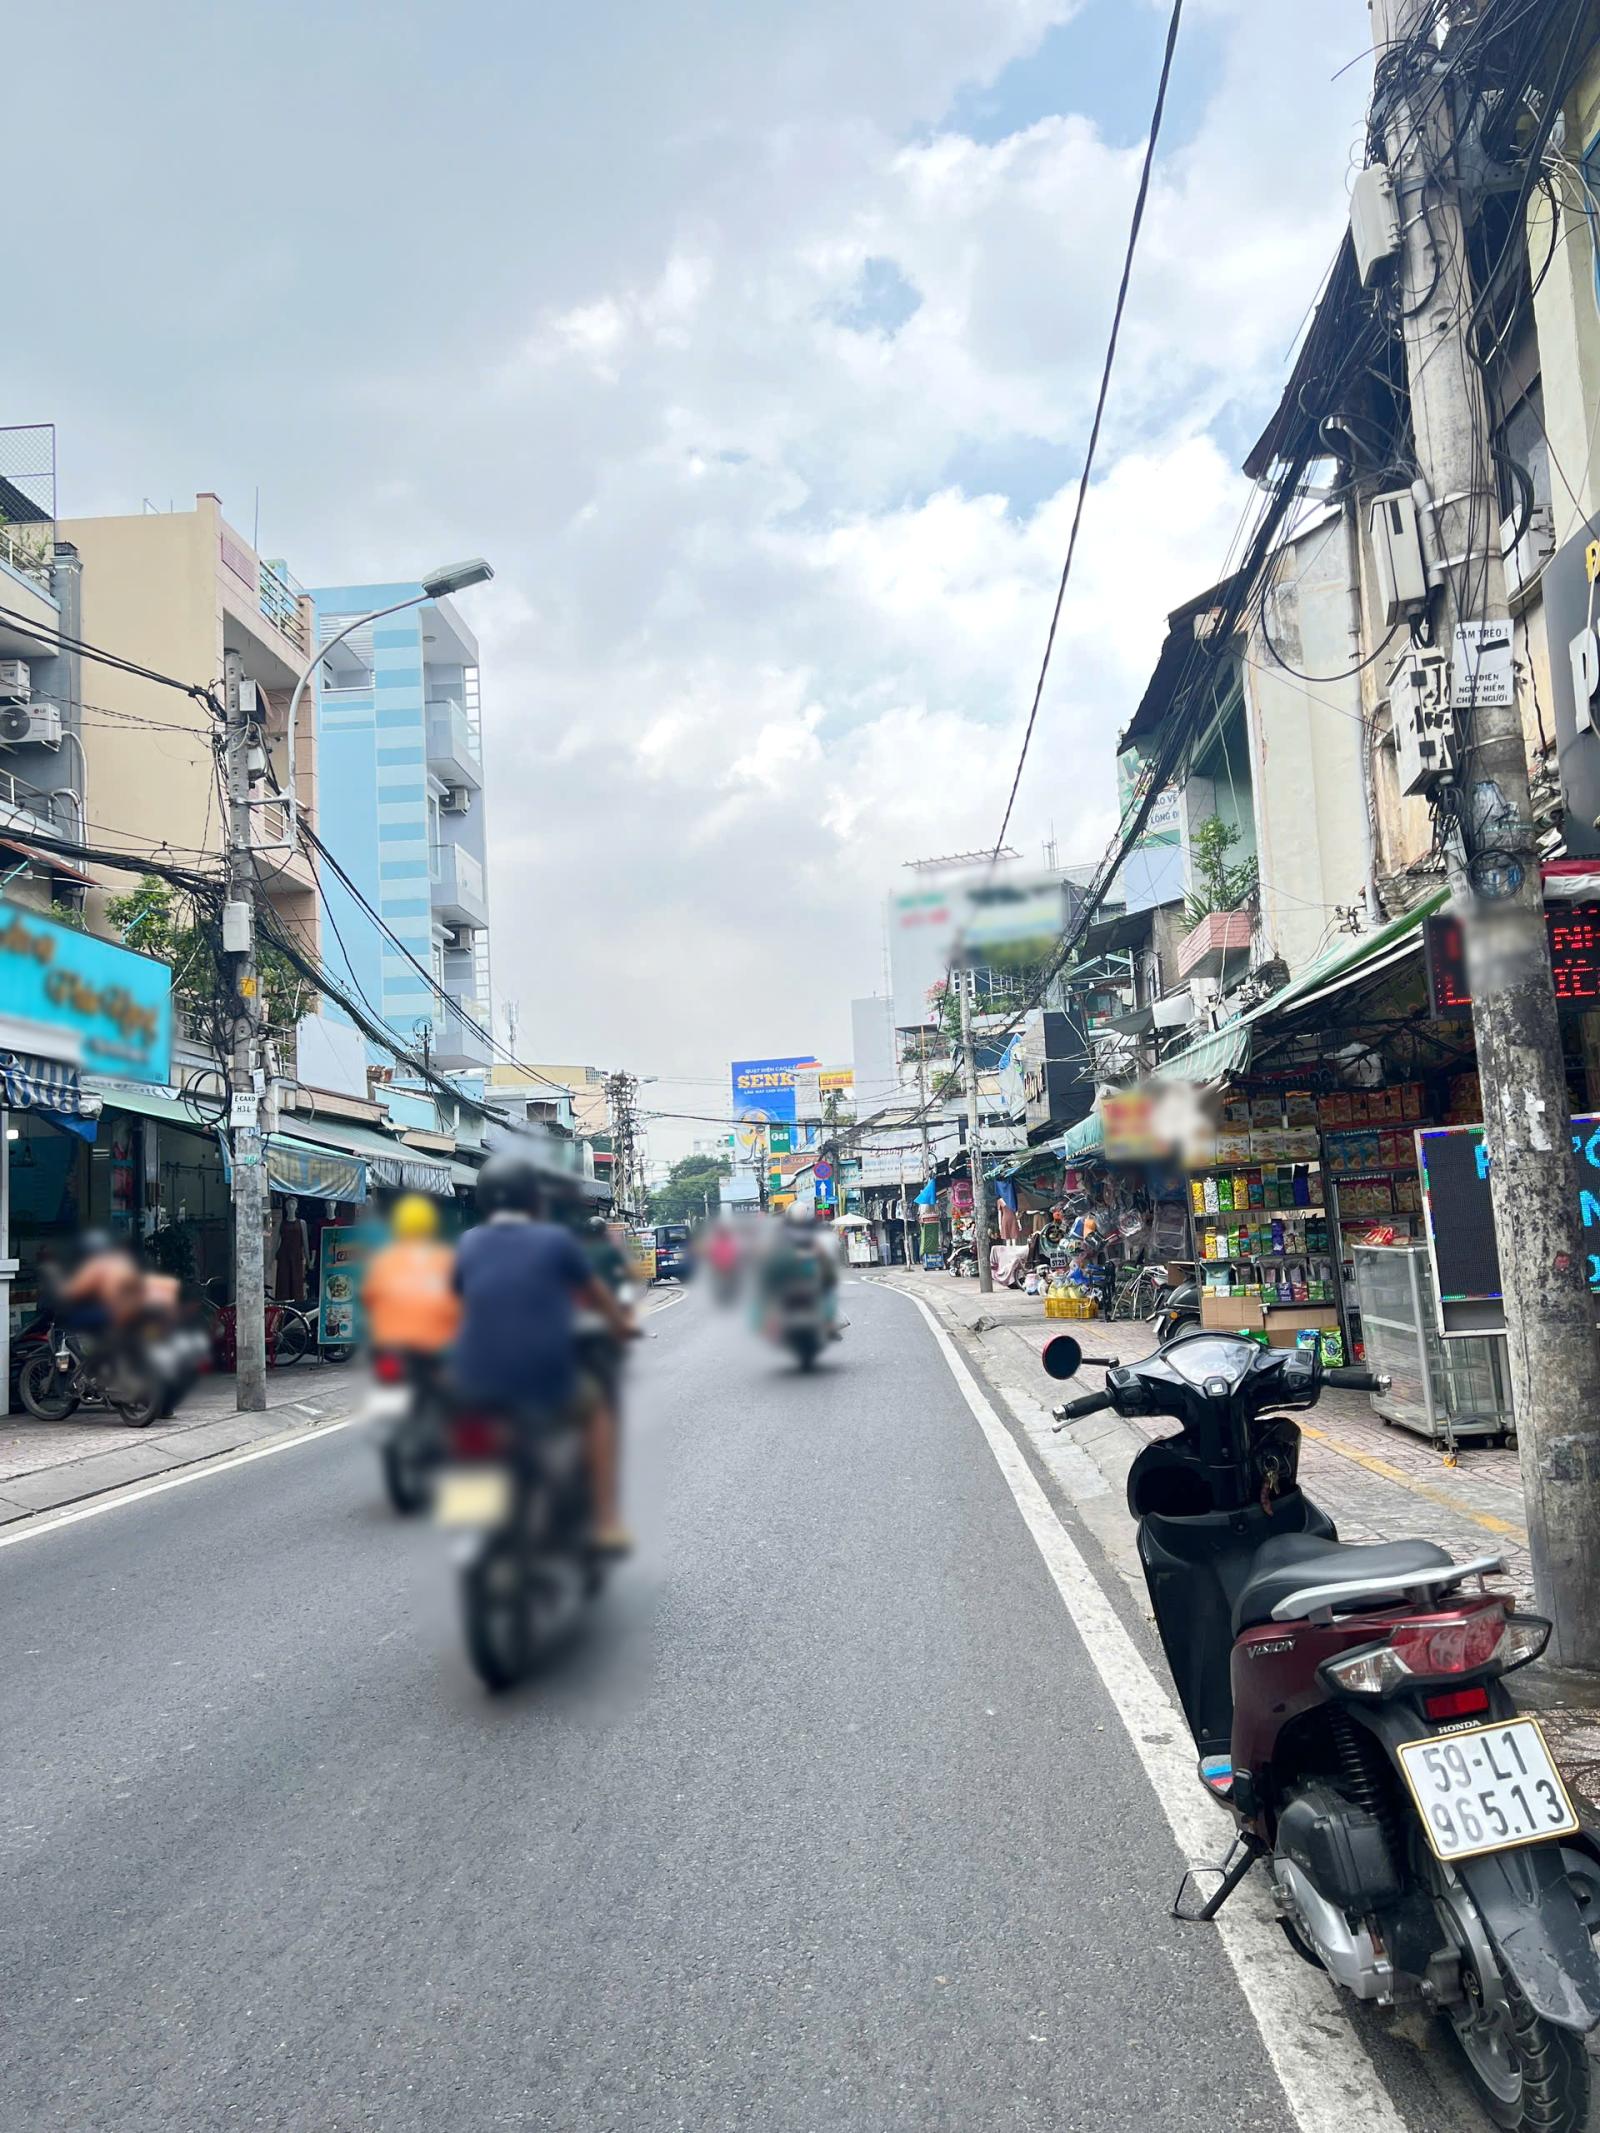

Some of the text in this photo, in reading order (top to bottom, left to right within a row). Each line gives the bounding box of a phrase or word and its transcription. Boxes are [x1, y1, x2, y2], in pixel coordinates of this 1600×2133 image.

[737, 1073, 797, 1088] SENK
[1246, 1639, 1296, 1660] VISION
[1438, 1719, 1482, 1734] HONDA
[1422, 1731, 1528, 1792] 59-L1
[1431, 1779, 1565, 1848] 965.13
